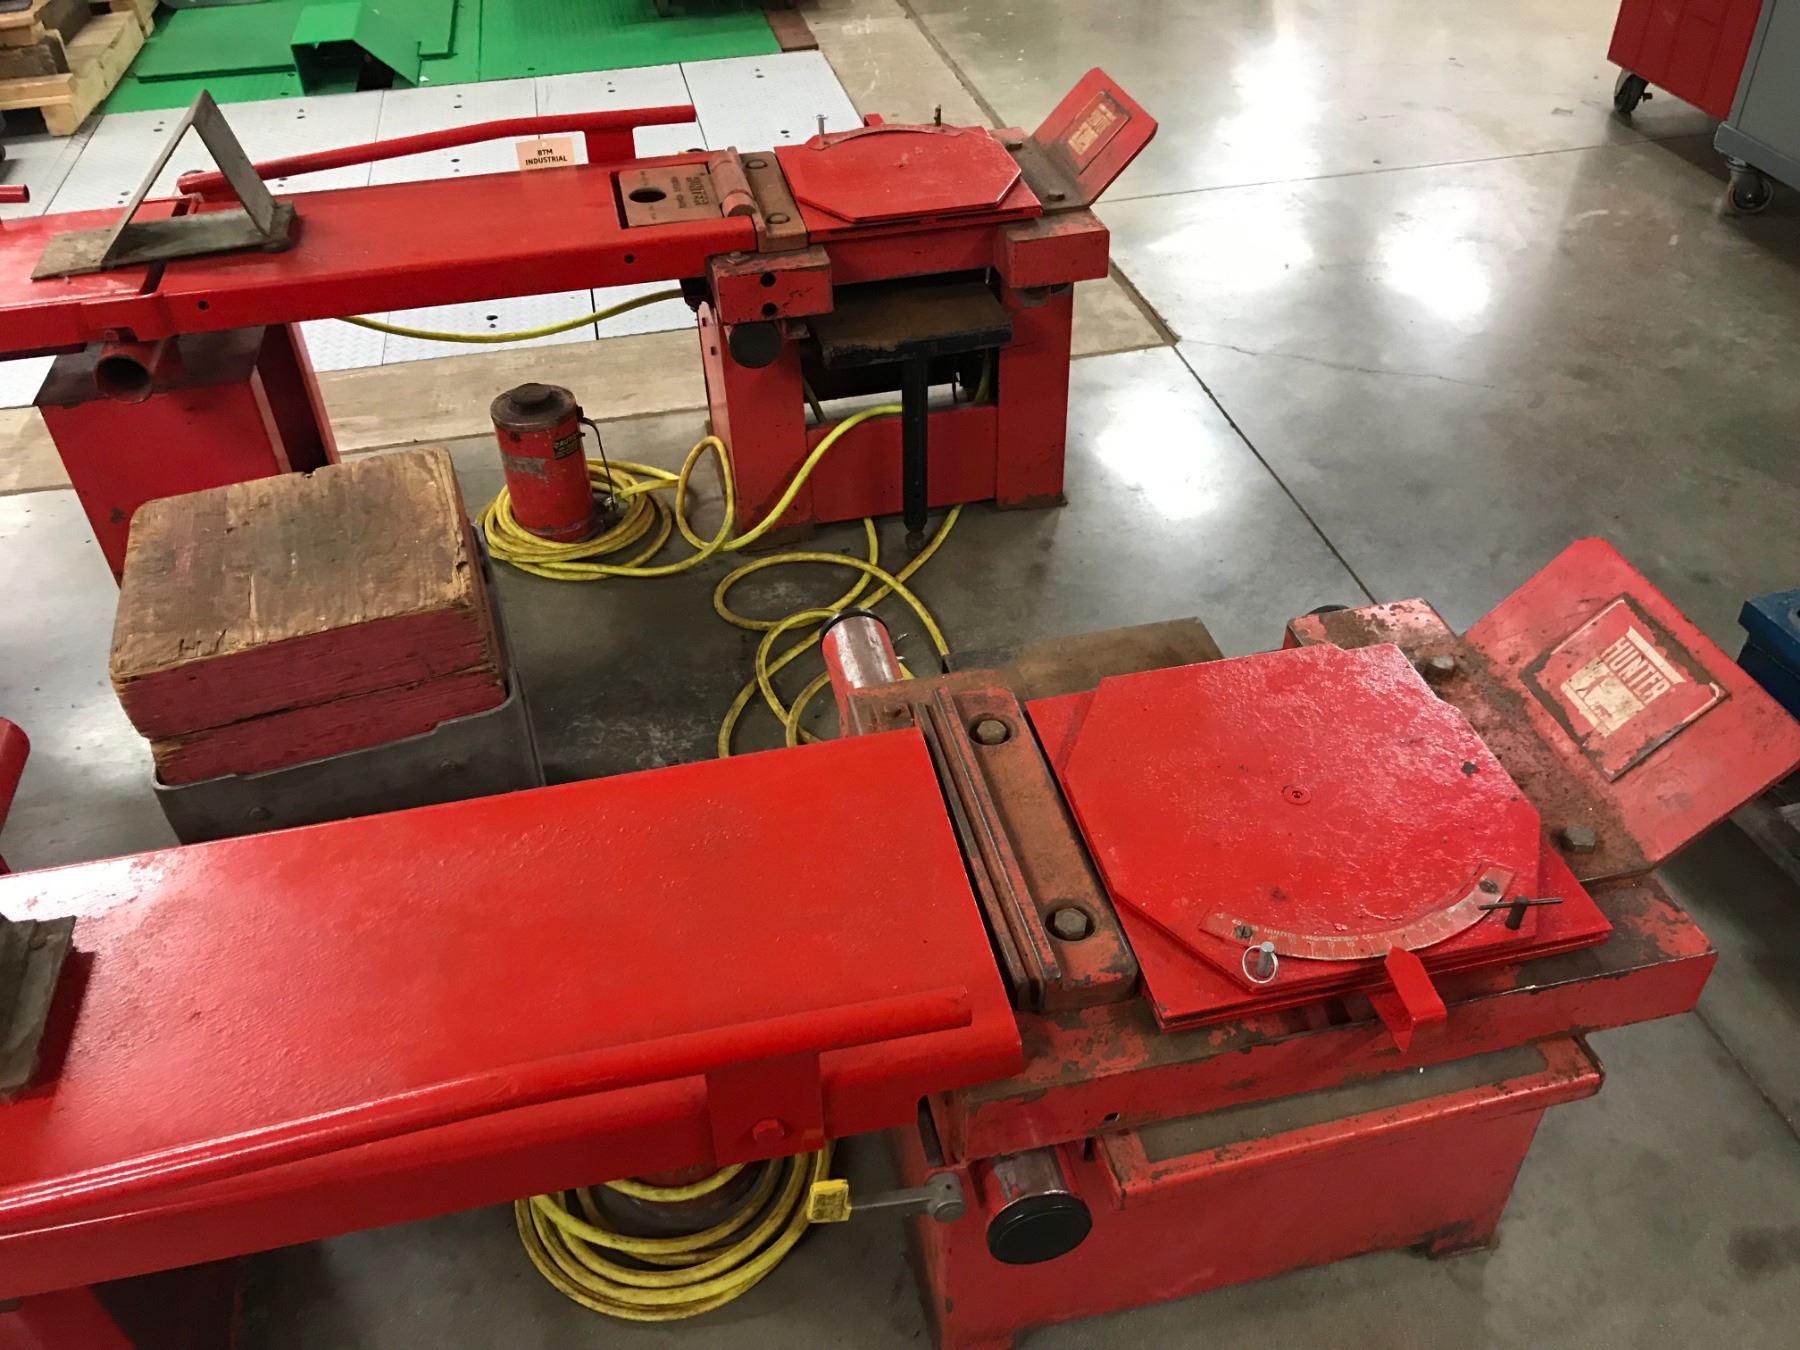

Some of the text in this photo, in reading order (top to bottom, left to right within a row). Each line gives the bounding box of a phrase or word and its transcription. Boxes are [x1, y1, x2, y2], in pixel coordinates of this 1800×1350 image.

[537, 148, 553, 156] BTM
[525, 155, 568, 165] INDUSTRIAL
[1600, 636, 1672, 705] HUNTER
